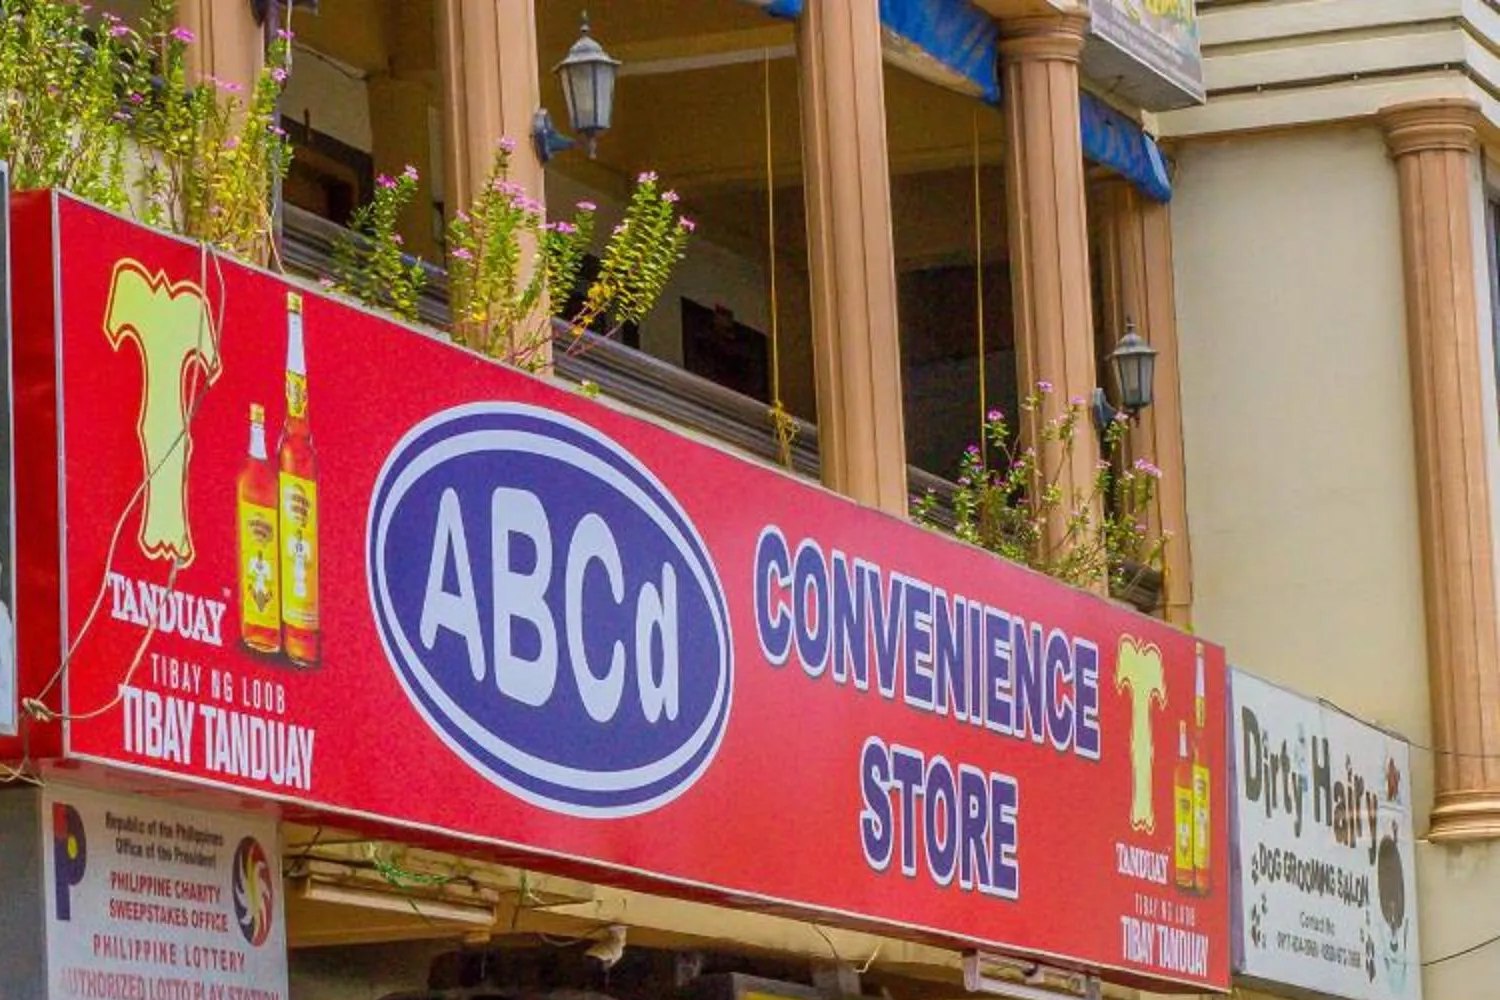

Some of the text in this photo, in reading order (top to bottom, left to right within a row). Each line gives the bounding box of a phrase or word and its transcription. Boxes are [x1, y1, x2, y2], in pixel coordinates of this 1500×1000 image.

[108, 571, 227, 647] TANDUAY
[419, 487, 679, 724] ABCd
[754, 523, 1101, 761] CONVENIENCE
[151, 653, 286, 715] TIBAY NG LOOB
[118, 684, 315, 791] TIBAY TANDUAY
[1241, 705, 1378, 866] Dirty Hairy
[105, 811, 145, 837] Republic
[148, 820, 157, 836] of
[176, 822, 224, 847] Philippines
[860, 735, 1019, 899] STORE
[116, 837, 143, 858] Office
[145, 841, 155, 858] of
[173, 845, 217, 870] President
[1116, 842, 1169, 885] TANDUAY
[1259, 842, 1282, 884] DOG
[1284, 851, 1335, 896] GROOMING
[109, 897, 229, 933] SWEEPSTAKES OFFICE
[110, 871, 221, 904] PHILIPPINE CHARITY
[93, 934, 246, 975] PHILIPPINE LOTTERY
[1121, 914, 1209, 978] TIBAY TANDUAY
